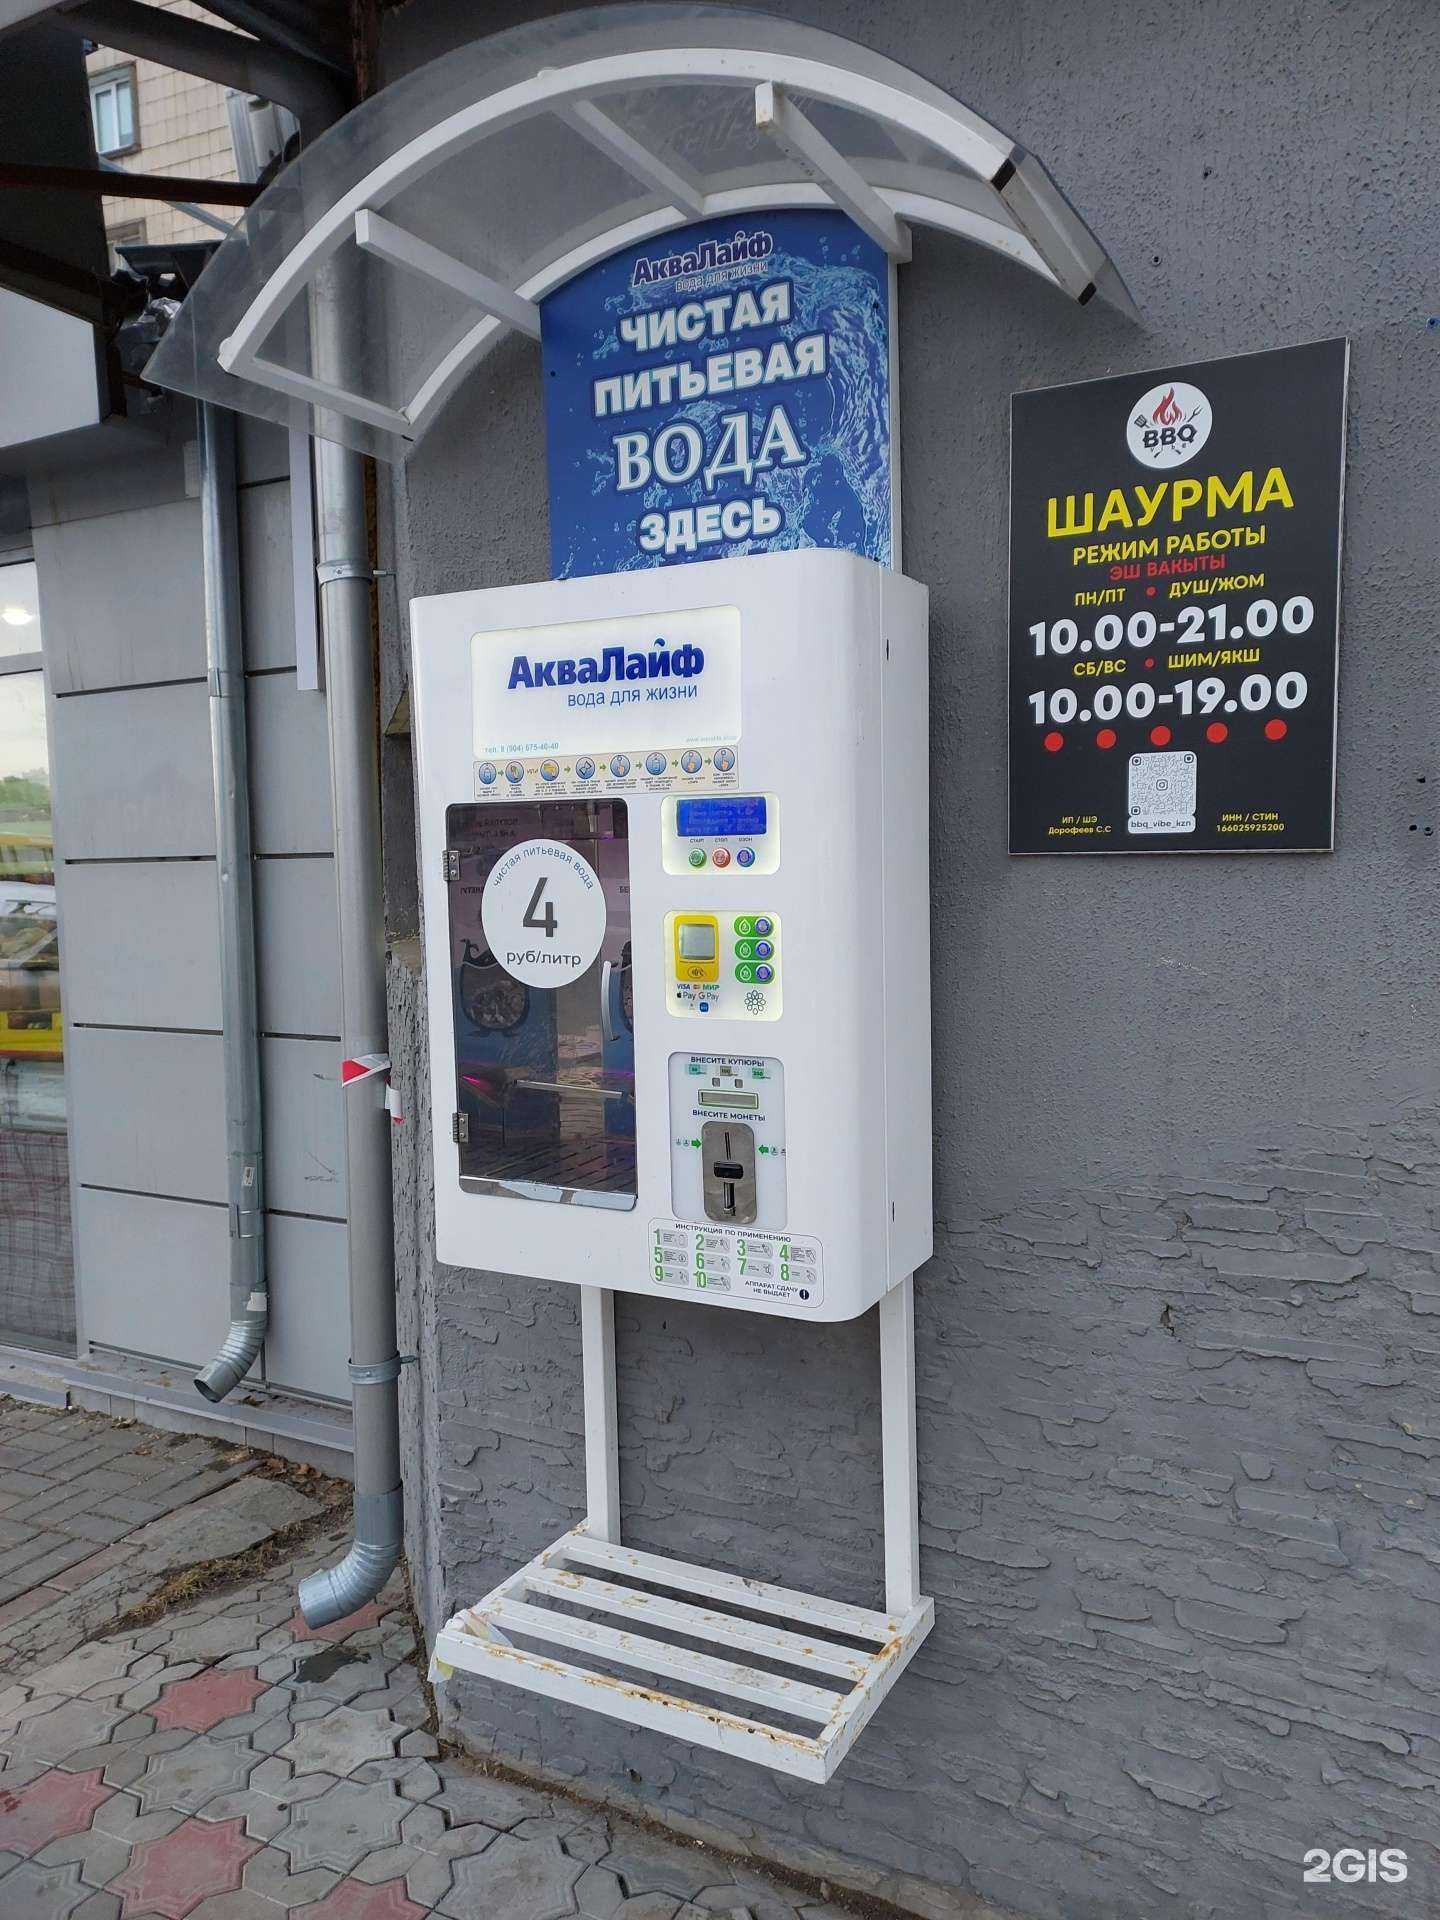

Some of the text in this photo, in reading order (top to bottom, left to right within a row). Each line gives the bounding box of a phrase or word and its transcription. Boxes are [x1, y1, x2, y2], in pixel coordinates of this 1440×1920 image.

[632, 230, 773, 287] АкваЛайф
[676, 260, 768, 292] вода для жизни
[620, 281, 791, 352] ЧИСТАЯ
[594, 333, 826, 417] ПИТЬЕВАЯ
[1142, 423, 1198, 448] BBQ
[612, 404, 805, 491] ВОДА
[1047, 467, 1295, 538] ШАУРМА
[639, 498, 782, 553] ЗДЕСЬ
[1073, 525, 1267, 566] РЕЖИМ РАБОТЫ
[1109, 554, 1226, 582] ЭШ ВАКЫТЫ
[1075, 573, 1265, 606] ПН/ПТ ДУШ/ЖОМ
[1029, 596, 1314, 656] 10.00-21.00
[507, 637, 705, 689] АкваЛайф
[1073, 648, 1260, 676] СБ/ВС ШИМ/ЯКШ
[568, 685, 698, 708] вода для жизни
[1029, 671, 1308, 724] 10.00-19.00
[1062, 816, 1075, 824] ИП
[1082, 815, 1098, 824] ШЭ
[1131, 819, 1192, 830] bbq_vibe_kzn
[1222, 813, 1242, 822] ИНН
[1252, 812, 1279, 821] СТИН
[1048, 827, 1094, 836] Дорофеев
[494, 846, 594, 890] чистая питьевая вода
[523, 877, 557, 937] 4
[506, 950, 581, 968] руб/литр
[683, 992, 696, 1001] Pay
[690, 1056, 765, 1067] ВНЕСИТЕ КУПЮРЫ
[692, 1109, 765, 1122] ВНЕСИТЕ МОНЕТЫ
[653, 1228, 661, 1245] 1
[675, 1223, 722, 1235] ИНСТРУКЦИЯ
[737, 1230, 792, 1242] ПРИМЕНЕНИЮ
[696, 1233, 704, 1251] 2
[736, 1239, 746, 1256] 3
[654, 1246, 663, 1264] 5
[696, 1252, 705, 1270] 6
[780, 1244, 789, 1262] 4
[654, 1265, 664, 1282] 9
[737, 1257, 747, 1275] 7
[780, 1263, 790, 1281] 8
[693, 1270, 707, 1288] 10
[745, 1280, 799, 1293] АППАРАТ СДАЧУ
